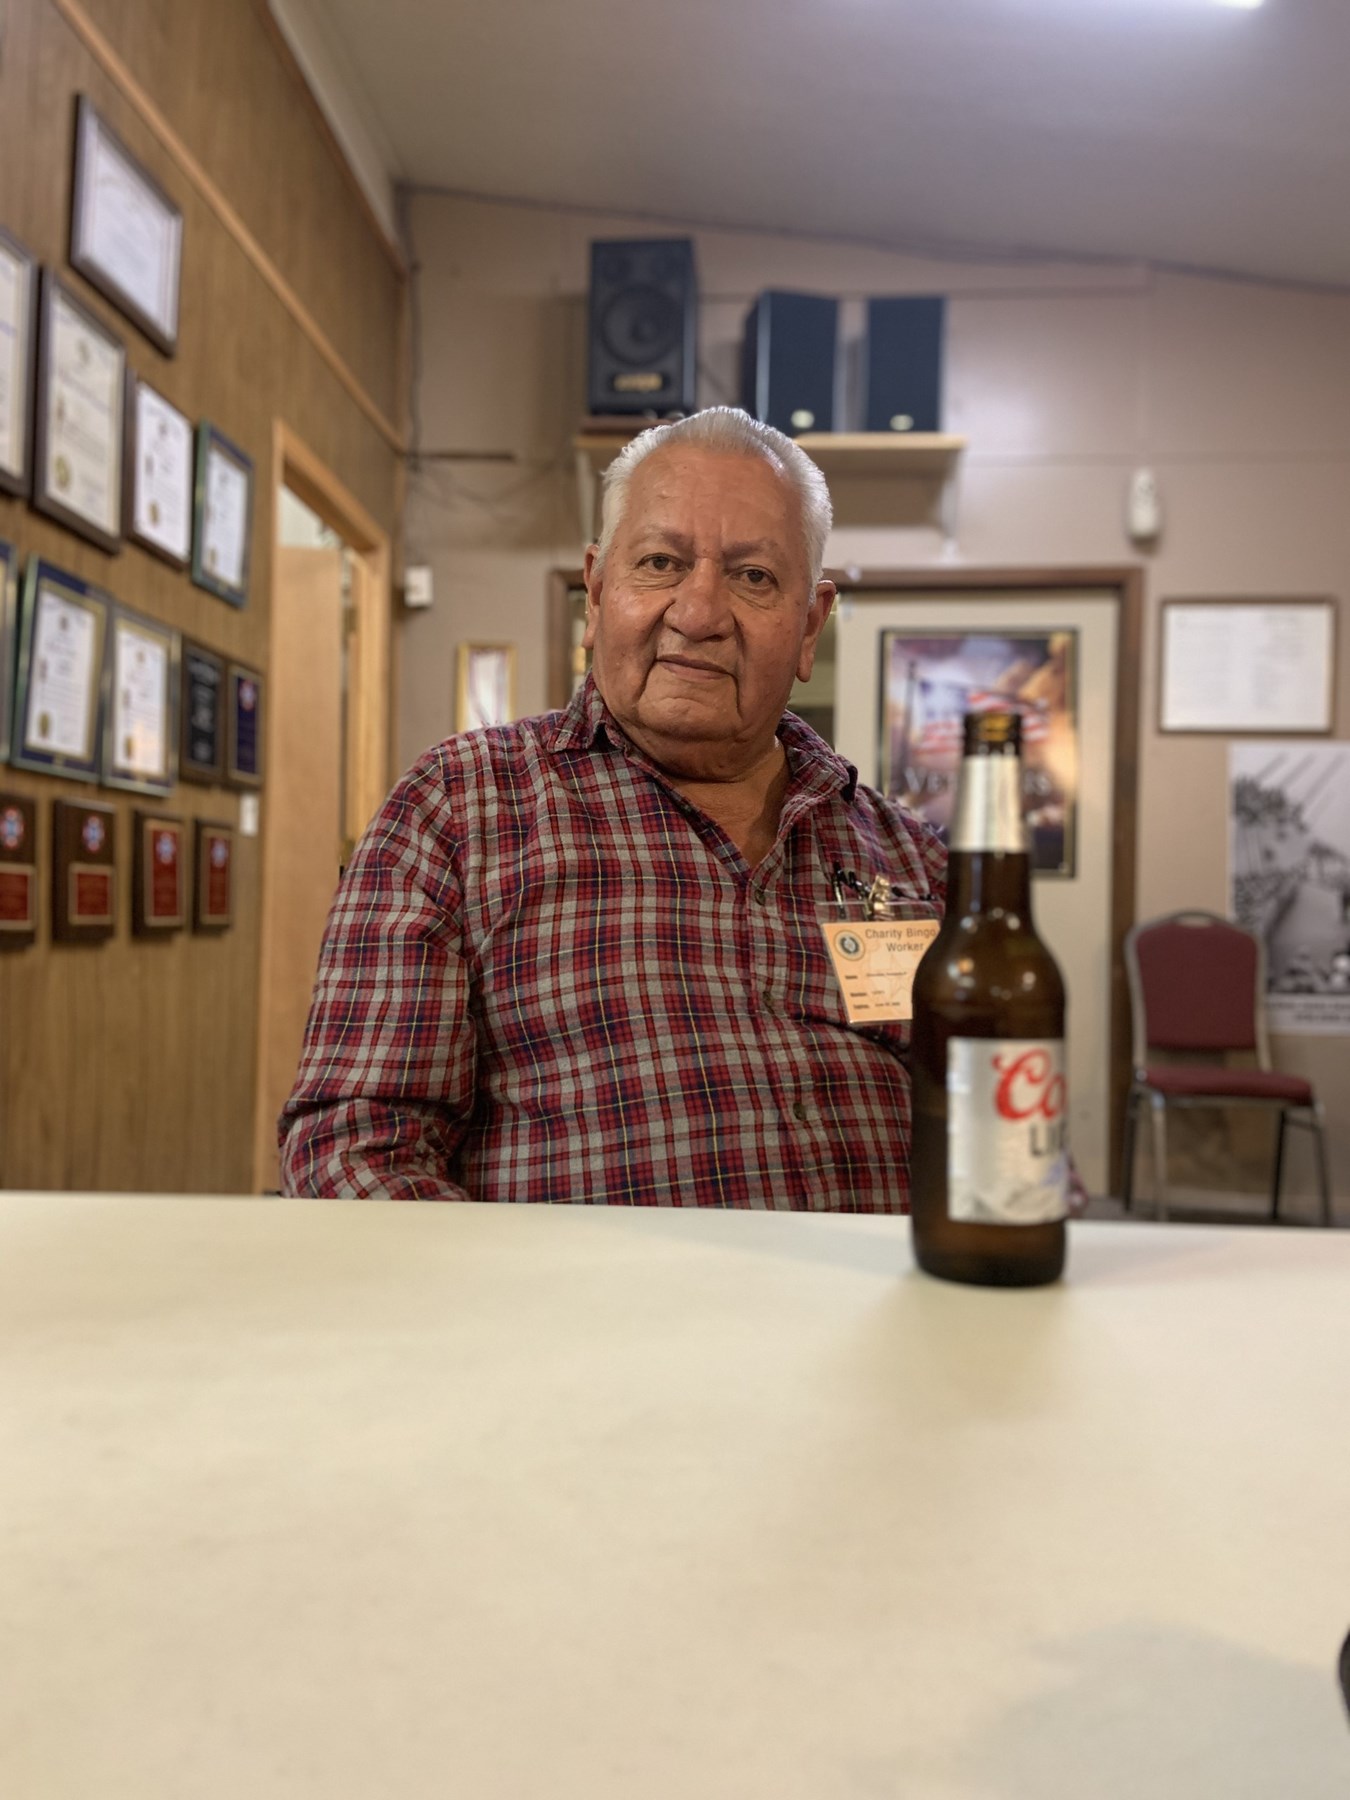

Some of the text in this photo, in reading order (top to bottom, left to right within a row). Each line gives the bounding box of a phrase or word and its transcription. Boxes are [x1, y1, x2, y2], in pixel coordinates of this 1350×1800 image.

[865, 928, 937, 940] Charity Bingo
[886, 943, 924, 952] Worker
